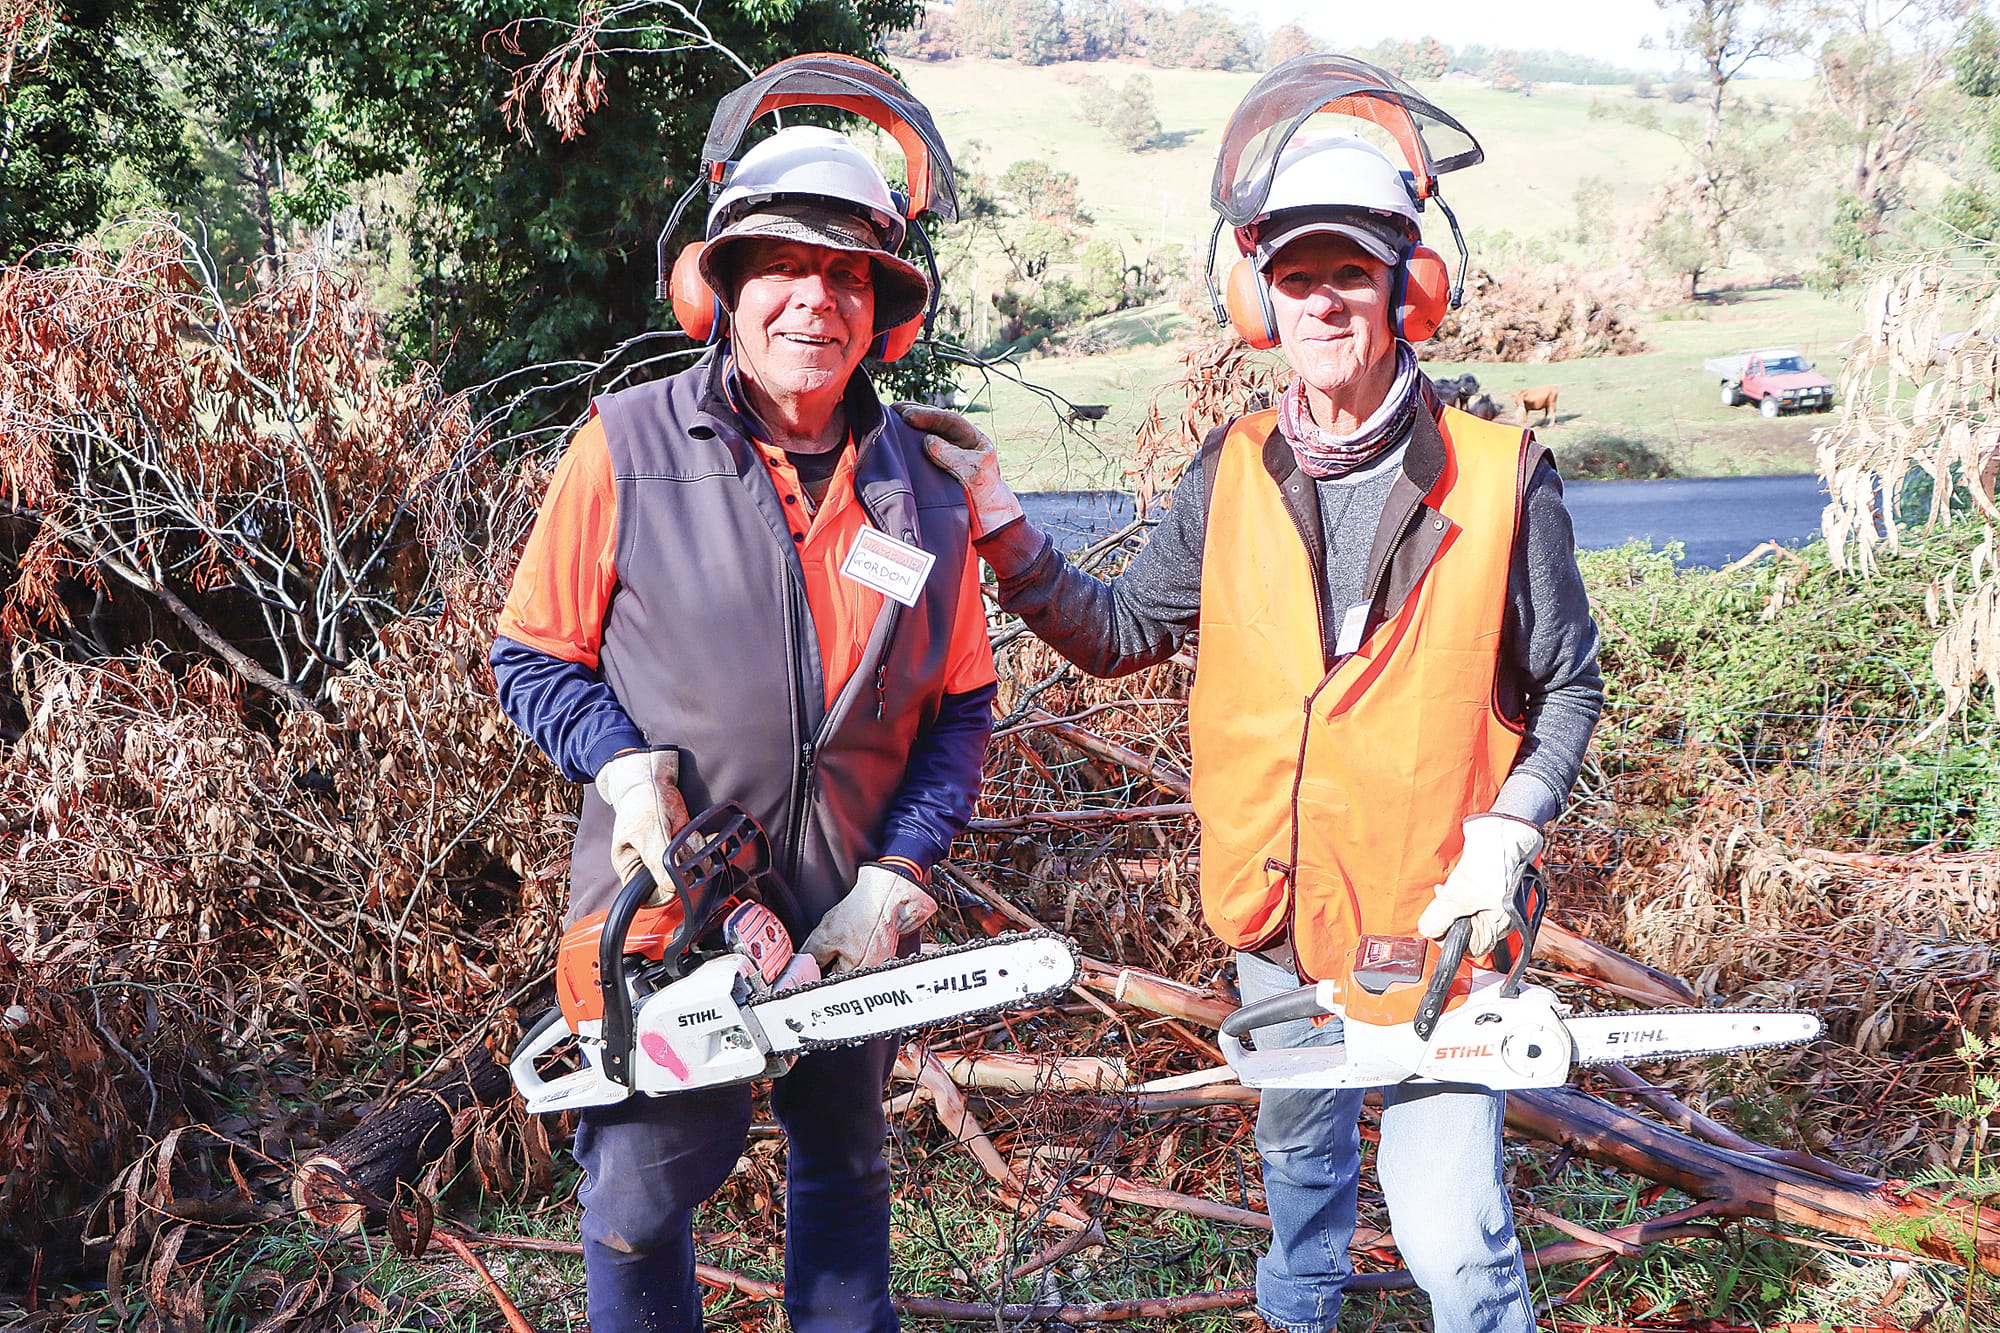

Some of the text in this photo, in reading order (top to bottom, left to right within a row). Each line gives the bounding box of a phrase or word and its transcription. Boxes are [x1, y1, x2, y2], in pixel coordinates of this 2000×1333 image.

[853, 551, 911, 586] GORDON
[823, 1000, 865, 1017] Boss
[863, 989, 913, 1012] Wood
[678, 1008, 722, 1027] STIHL
[1605, 1029, 1669, 1045] STIHL
[1434, 1044, 1494, 1060] STIHL
